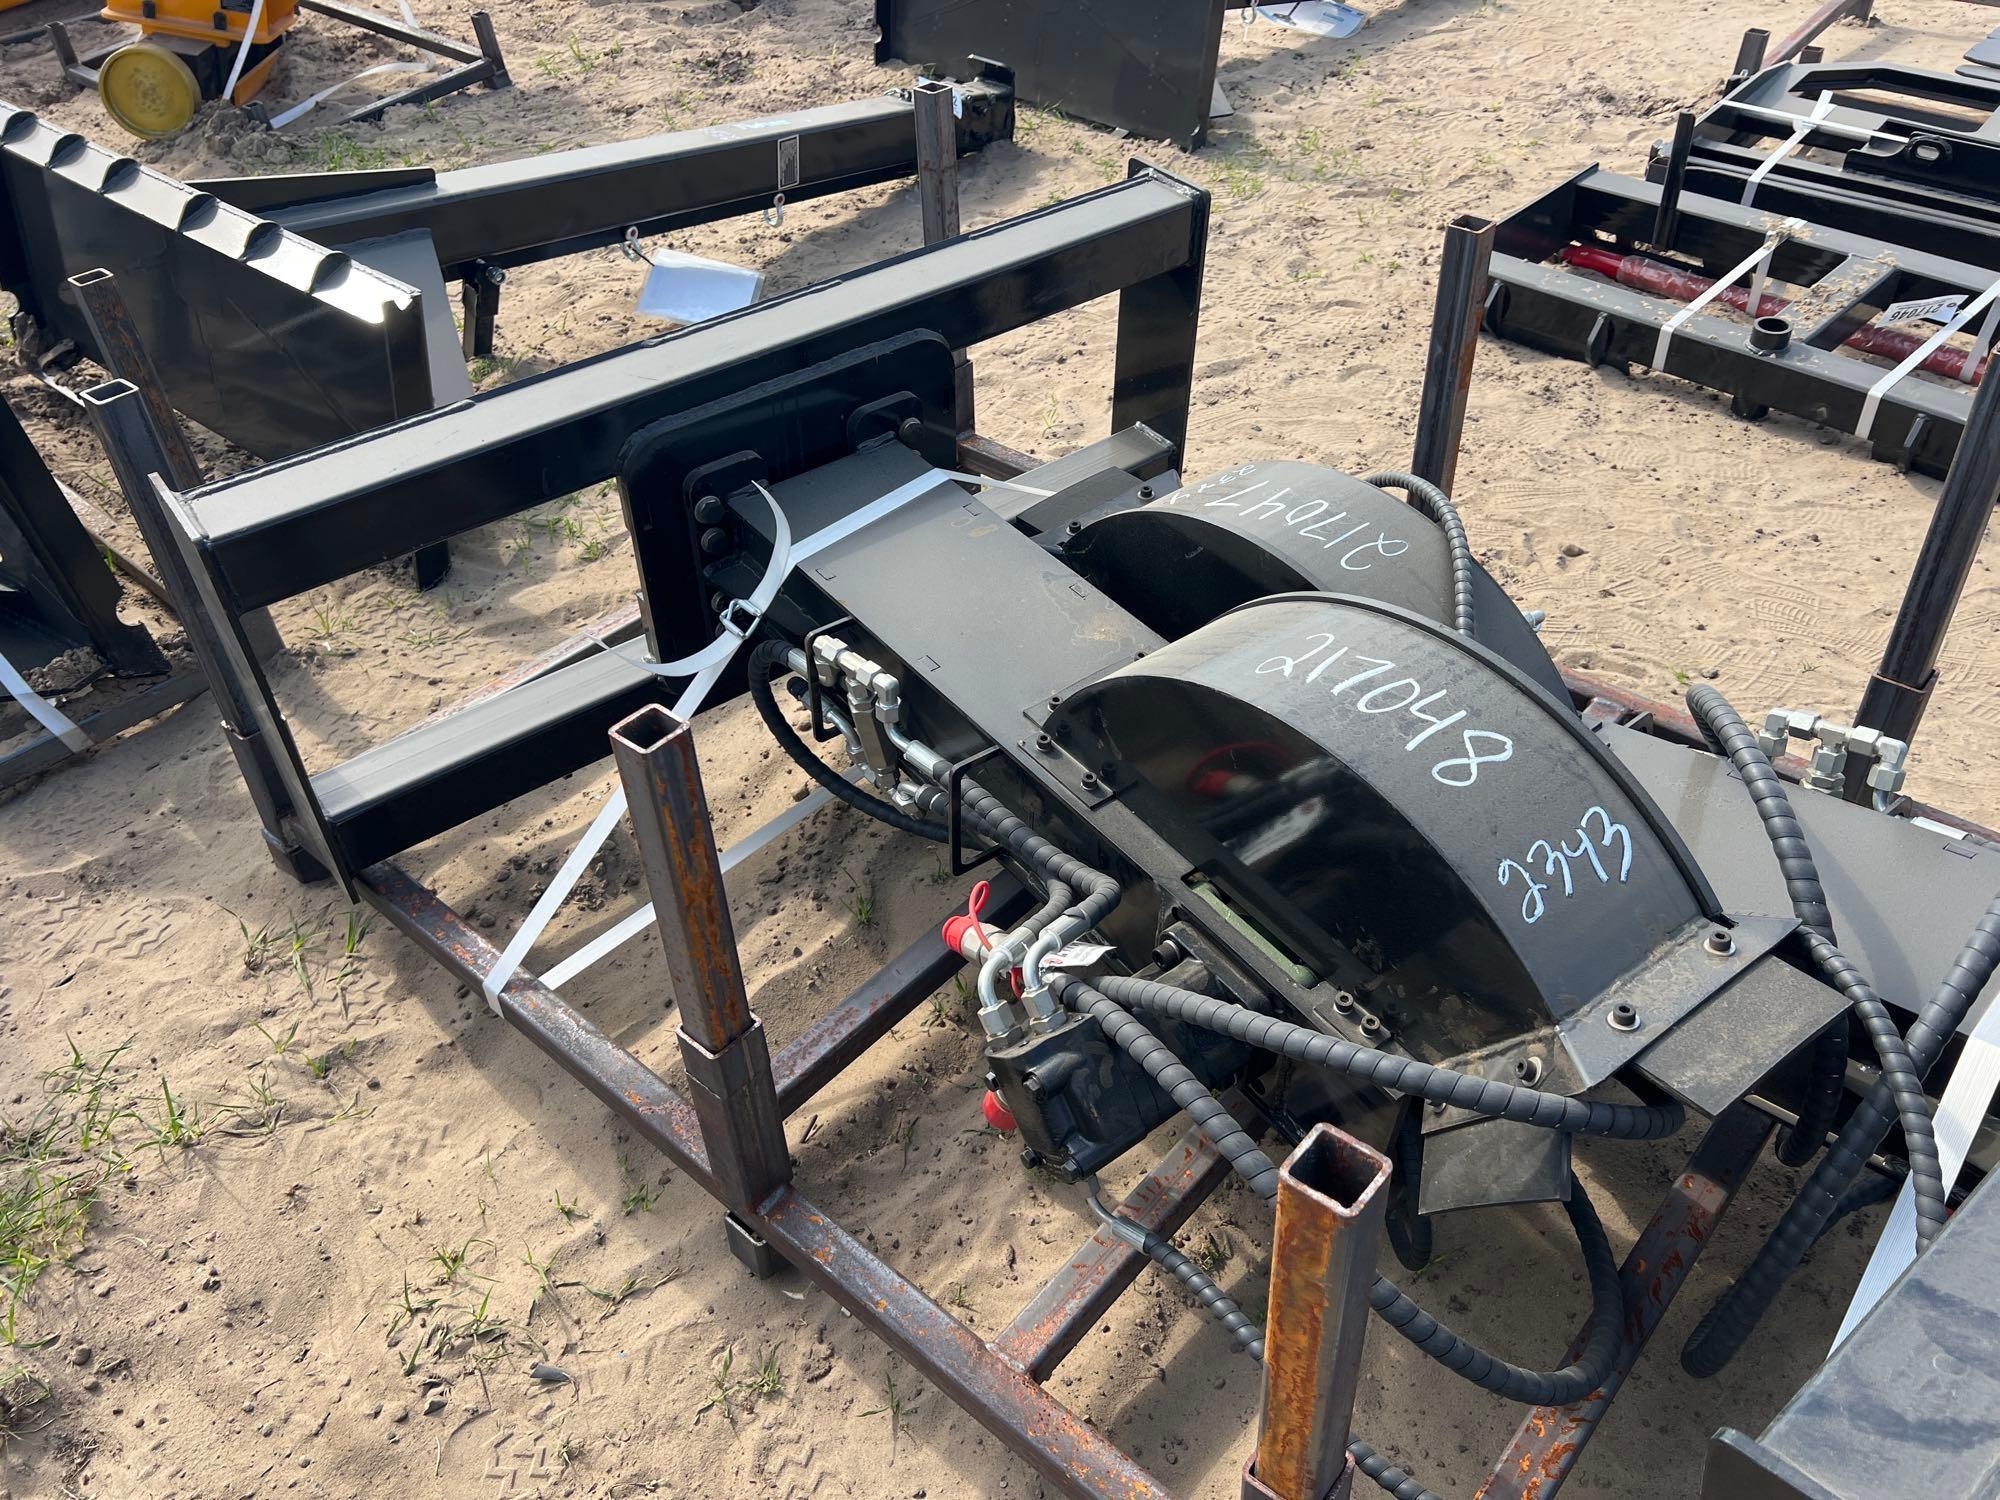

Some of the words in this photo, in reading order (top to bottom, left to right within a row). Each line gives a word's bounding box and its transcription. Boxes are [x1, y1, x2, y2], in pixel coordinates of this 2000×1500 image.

[1891, 304, 1943, 321] 217046
[1206, 480, 1409, 571] 217047
[1255, 633, 1513, 787] 217048
[1499, 806, 1633, 924] 2343
